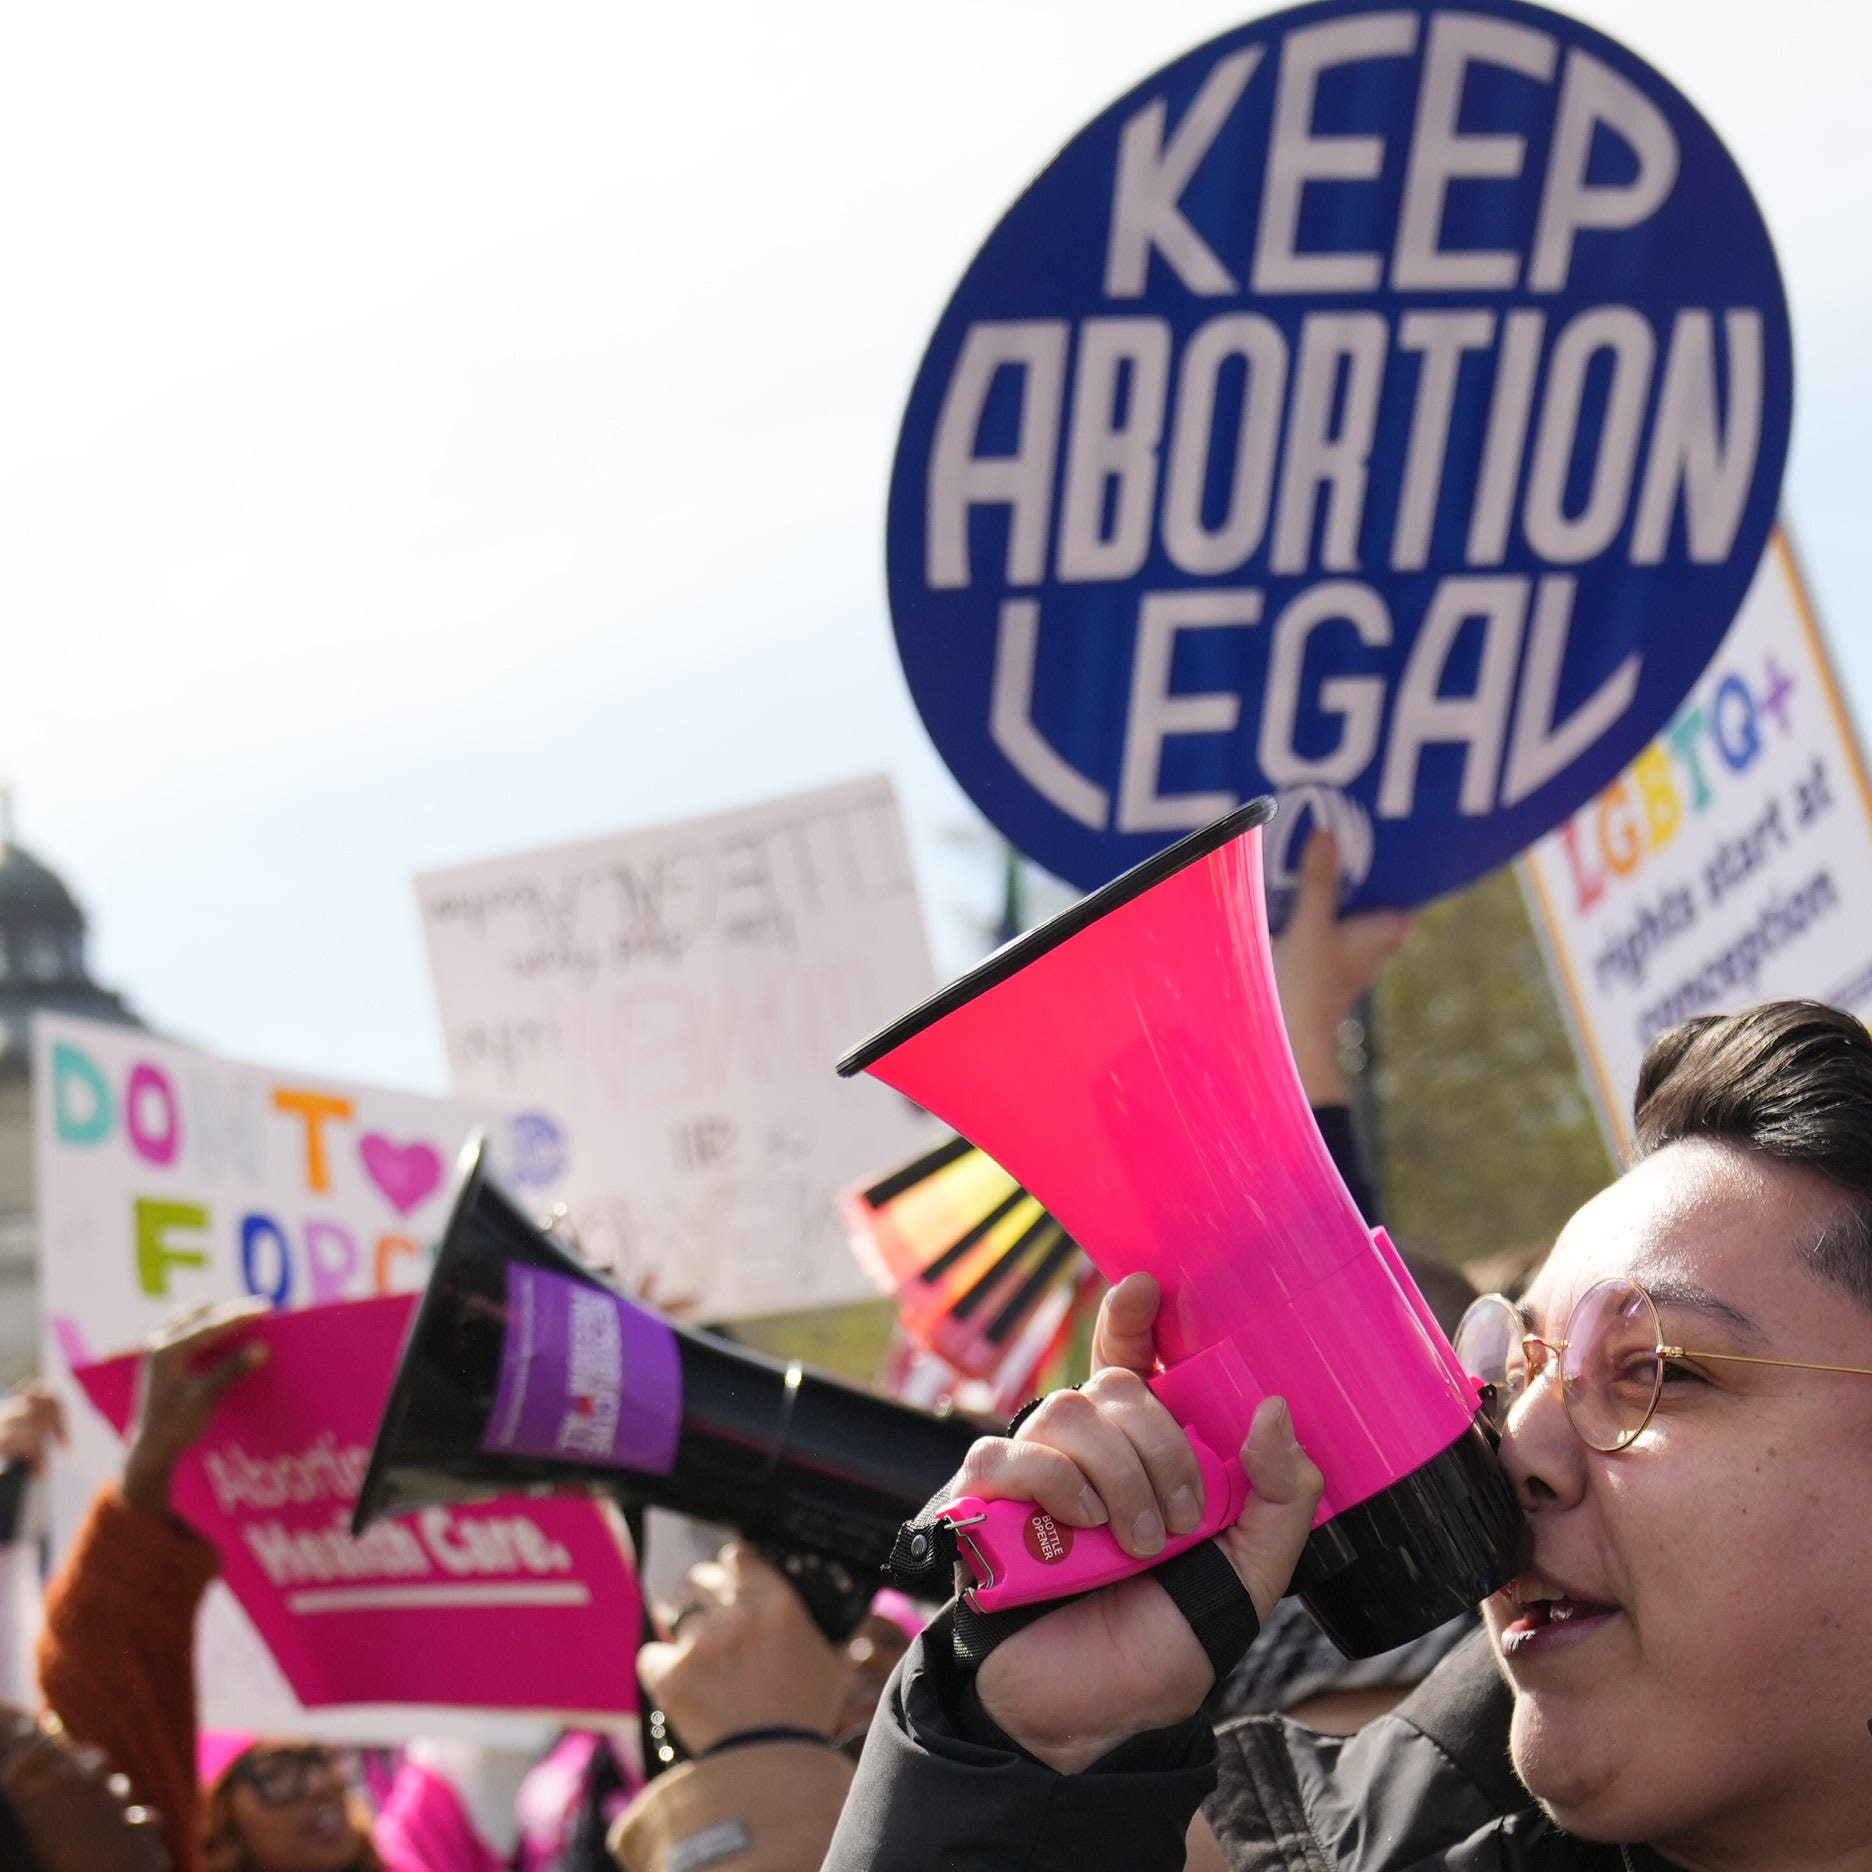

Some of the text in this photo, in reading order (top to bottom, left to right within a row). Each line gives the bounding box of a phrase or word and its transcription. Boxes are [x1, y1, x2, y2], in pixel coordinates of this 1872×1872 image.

[1103, 12, 1679, 298] KEEP
[926, 306, 1763, 589] ABORTION
[990, 577, 1644, 833] LEGAL
[1558, 654, 1799, 915] LGBTQ+
[1595, 761, 1834, 995] rights start at
[133, 1196, 440, 1310] FORC
[202, 1429, 370, 1515] Abortio
[418, 1507, 574, 1576] Care.
[1032, 1516, 1054, 1561] OPENER
[1041, 1515, 1064, 1556] BOTTLE
